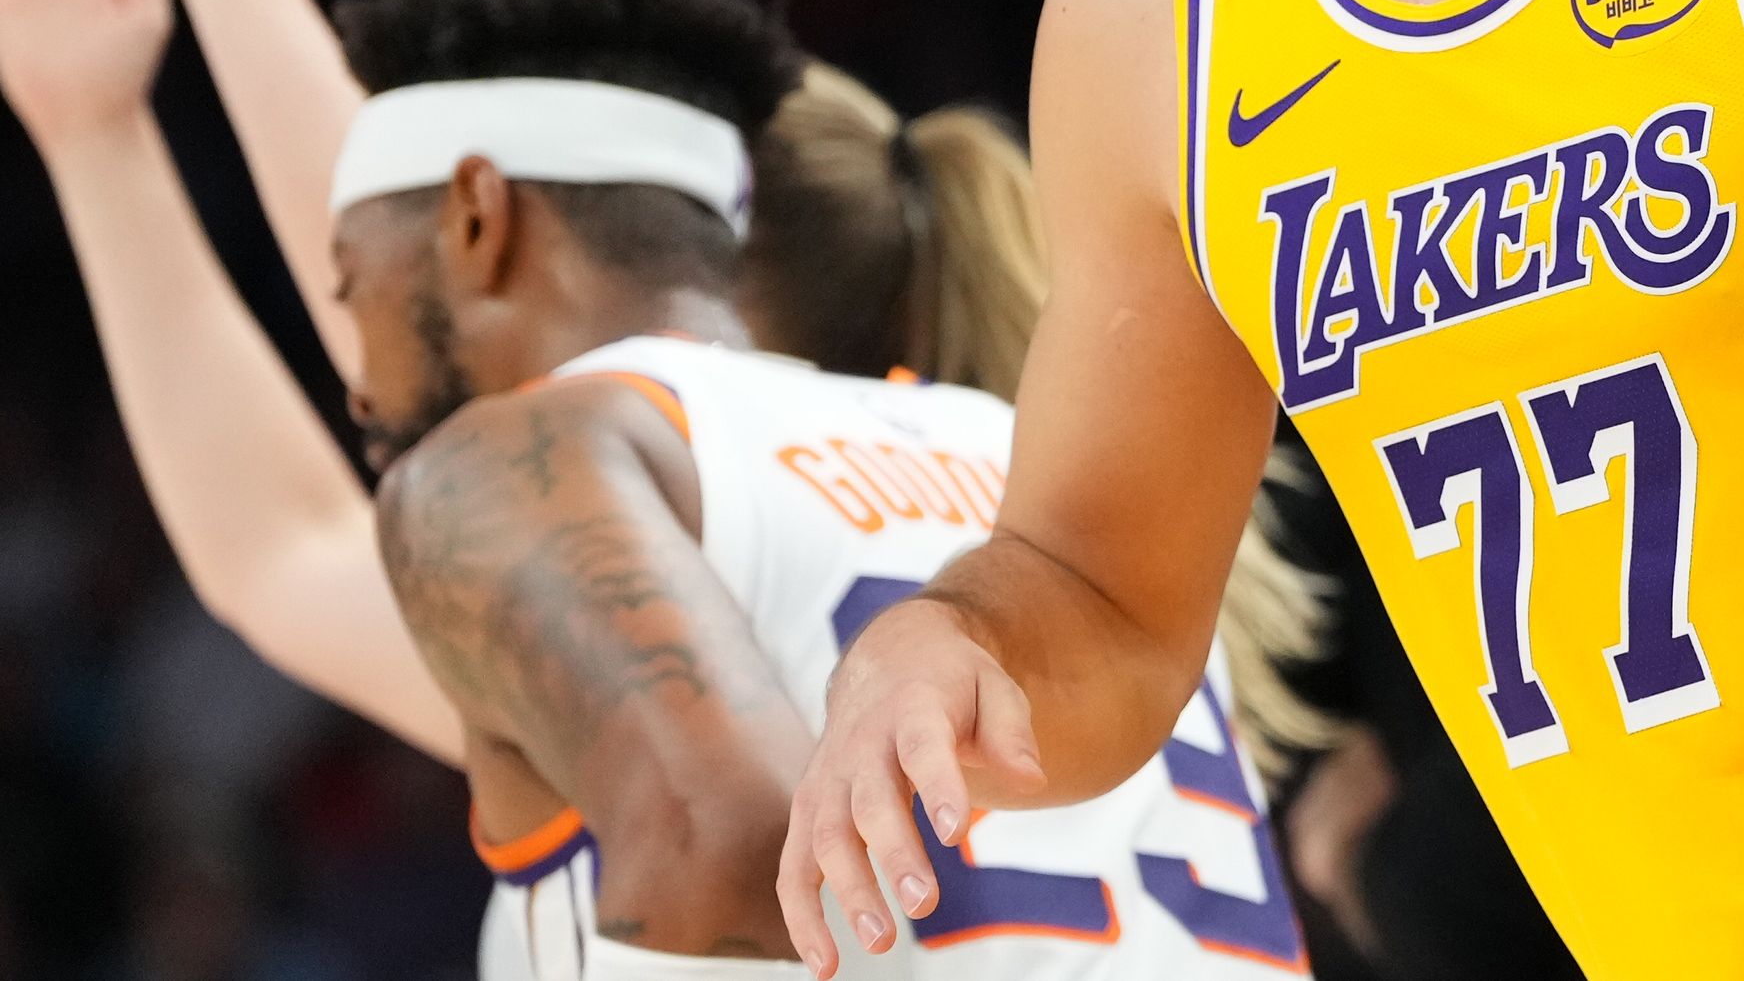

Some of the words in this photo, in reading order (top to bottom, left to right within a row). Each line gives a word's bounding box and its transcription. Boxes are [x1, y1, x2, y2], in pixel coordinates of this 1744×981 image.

[1258, 103, 1737, 415] LAKERS
[776, 438, 1007, 534] GOOD
[1372, 351, 1722, 769] 77
